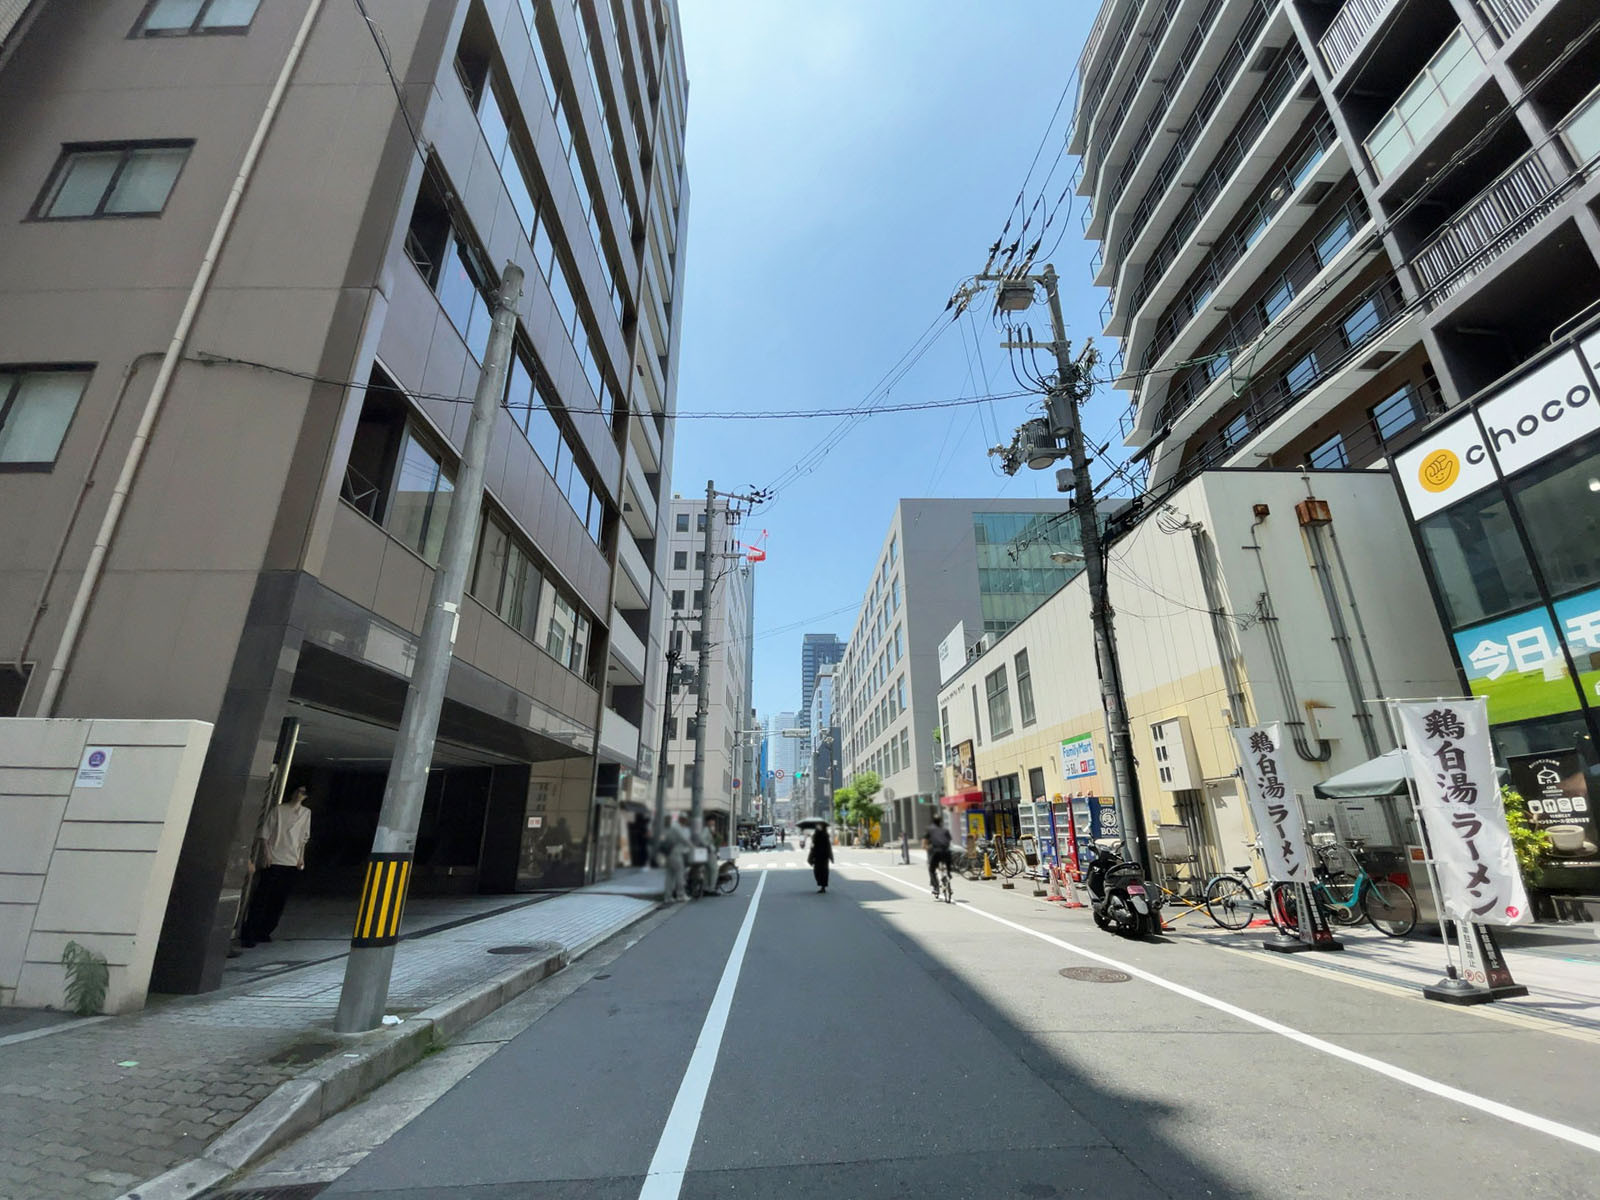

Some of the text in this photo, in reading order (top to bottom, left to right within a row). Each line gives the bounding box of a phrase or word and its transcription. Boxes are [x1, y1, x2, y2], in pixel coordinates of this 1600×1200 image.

[1466, 364, 1600, 465] choco
[1063, 741, 1093, 757] FamilyMart
[1249, 731, 1299, 876] 鶏白湯ラーメン
[1422, 708, 1498, 916] 鶏白湯ラーメン
